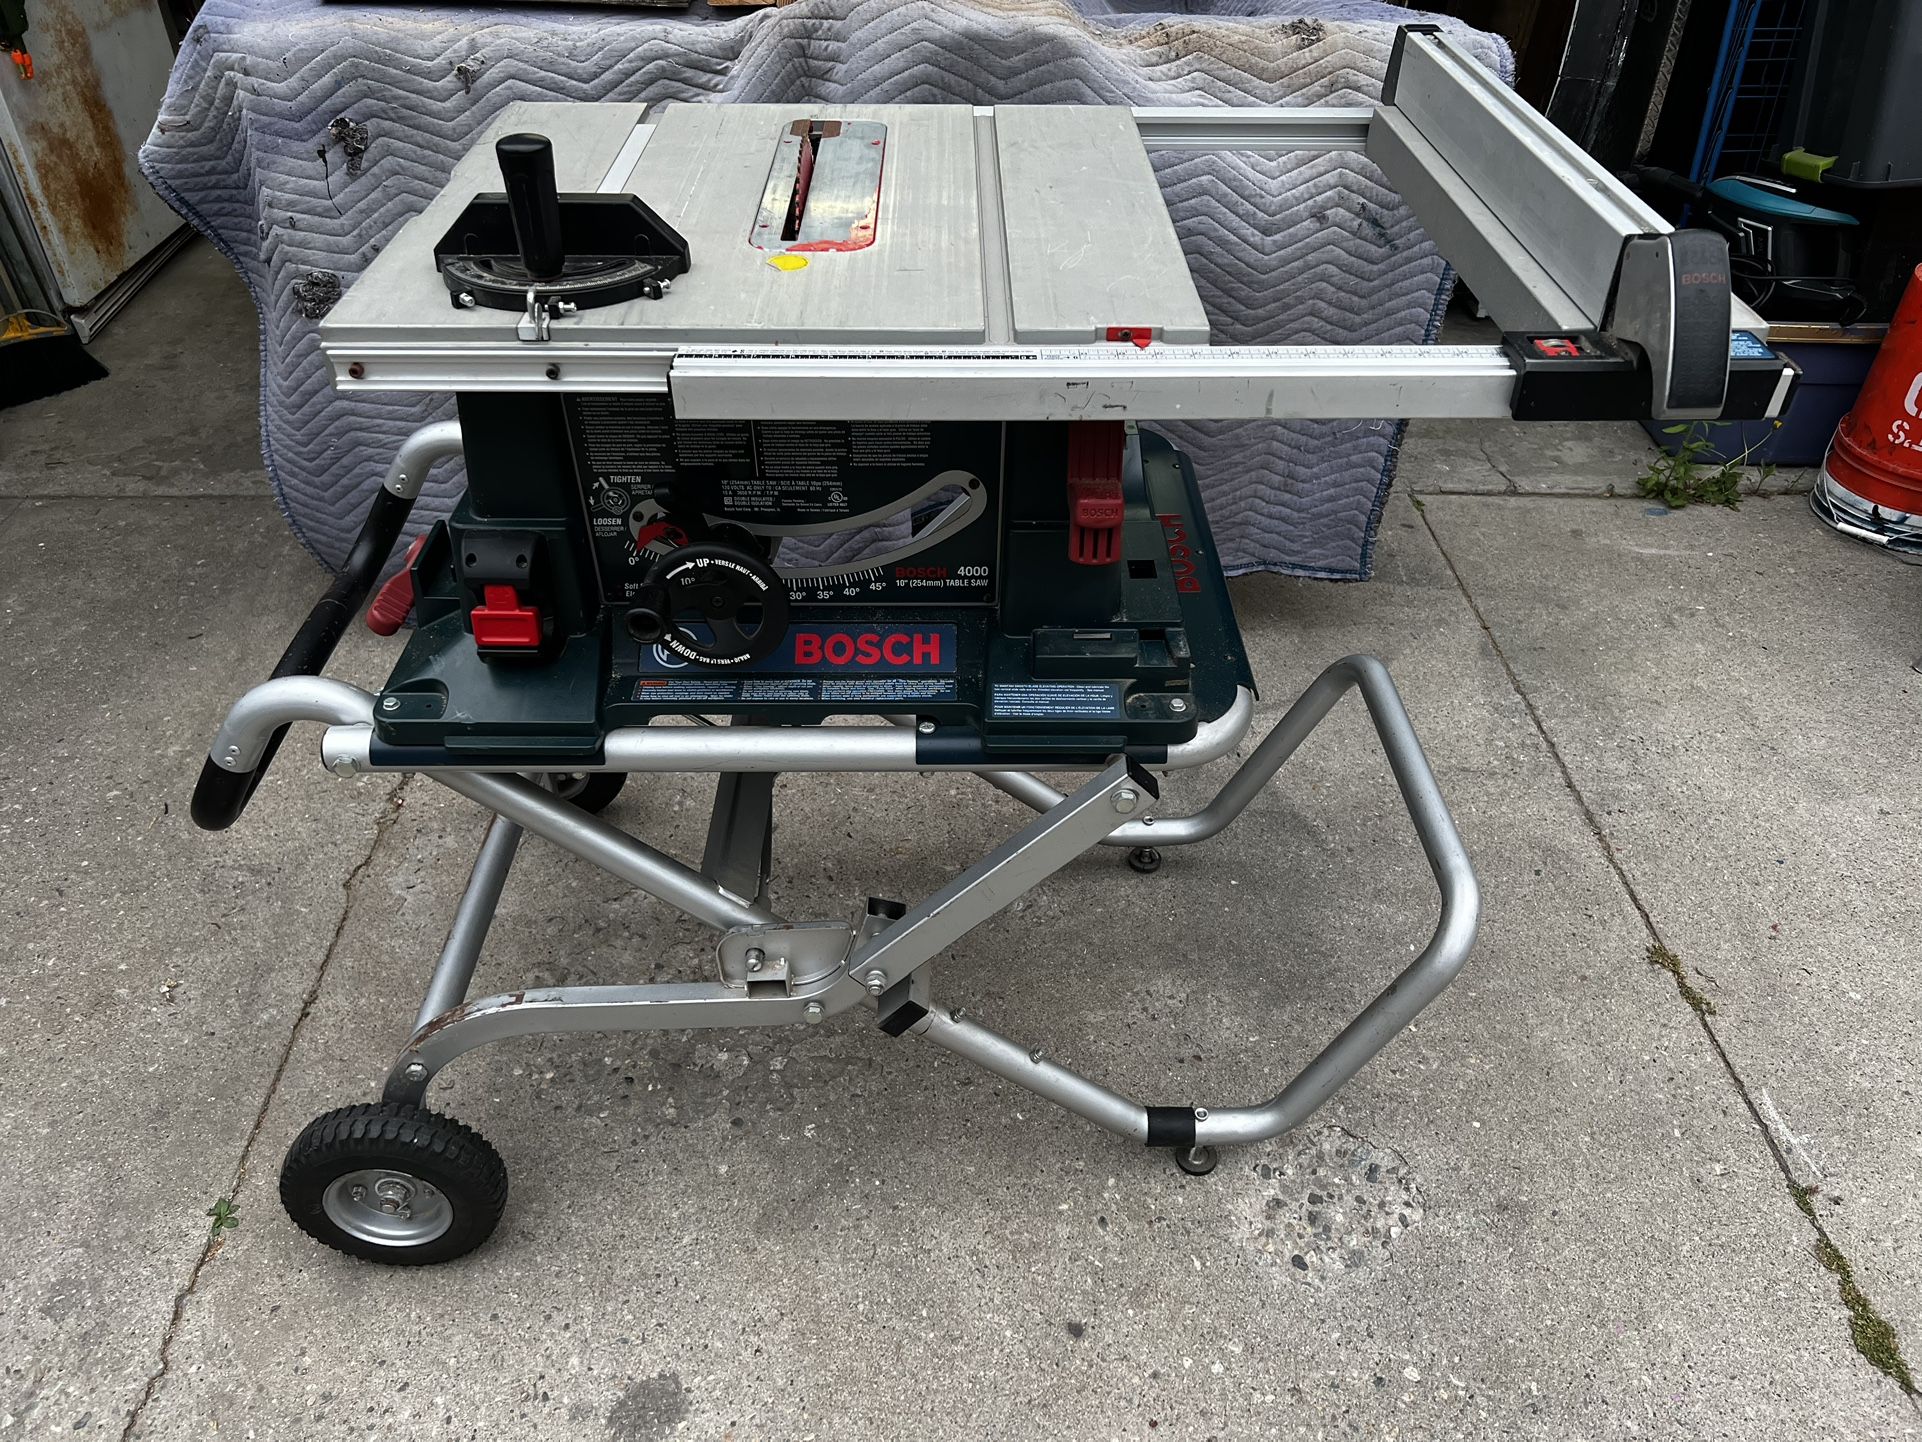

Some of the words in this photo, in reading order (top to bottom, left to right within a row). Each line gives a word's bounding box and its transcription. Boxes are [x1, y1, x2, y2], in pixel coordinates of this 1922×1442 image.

[1682, 273, 1727, 285] BOSCH
[609, 475, 642, 483] TIGHTEN
[1082, 507, 1119, 518] BOSCH
[593, 517, 622, 526] LOOSEN
[695, 558, 710, 568] UP
[895, 566, 949, 578] BOSCH
[957, 566, 989, 577] 4000
[624, 582, 639, 590] Soft
[869, 582, 887, 591] 45°
[909, 579, 944, 588] (254mm)
[946, 579, 969, 587] TABLE
[970, 579, 989, 587] SAW
[789, 591, 807, 601] 30°
[816, 590, 834, 599] 35°
[843, 587, 860, 597] 40°
[670, 639, 697, 660] DOWN
[794, 632, 941, 665] BOSCH
